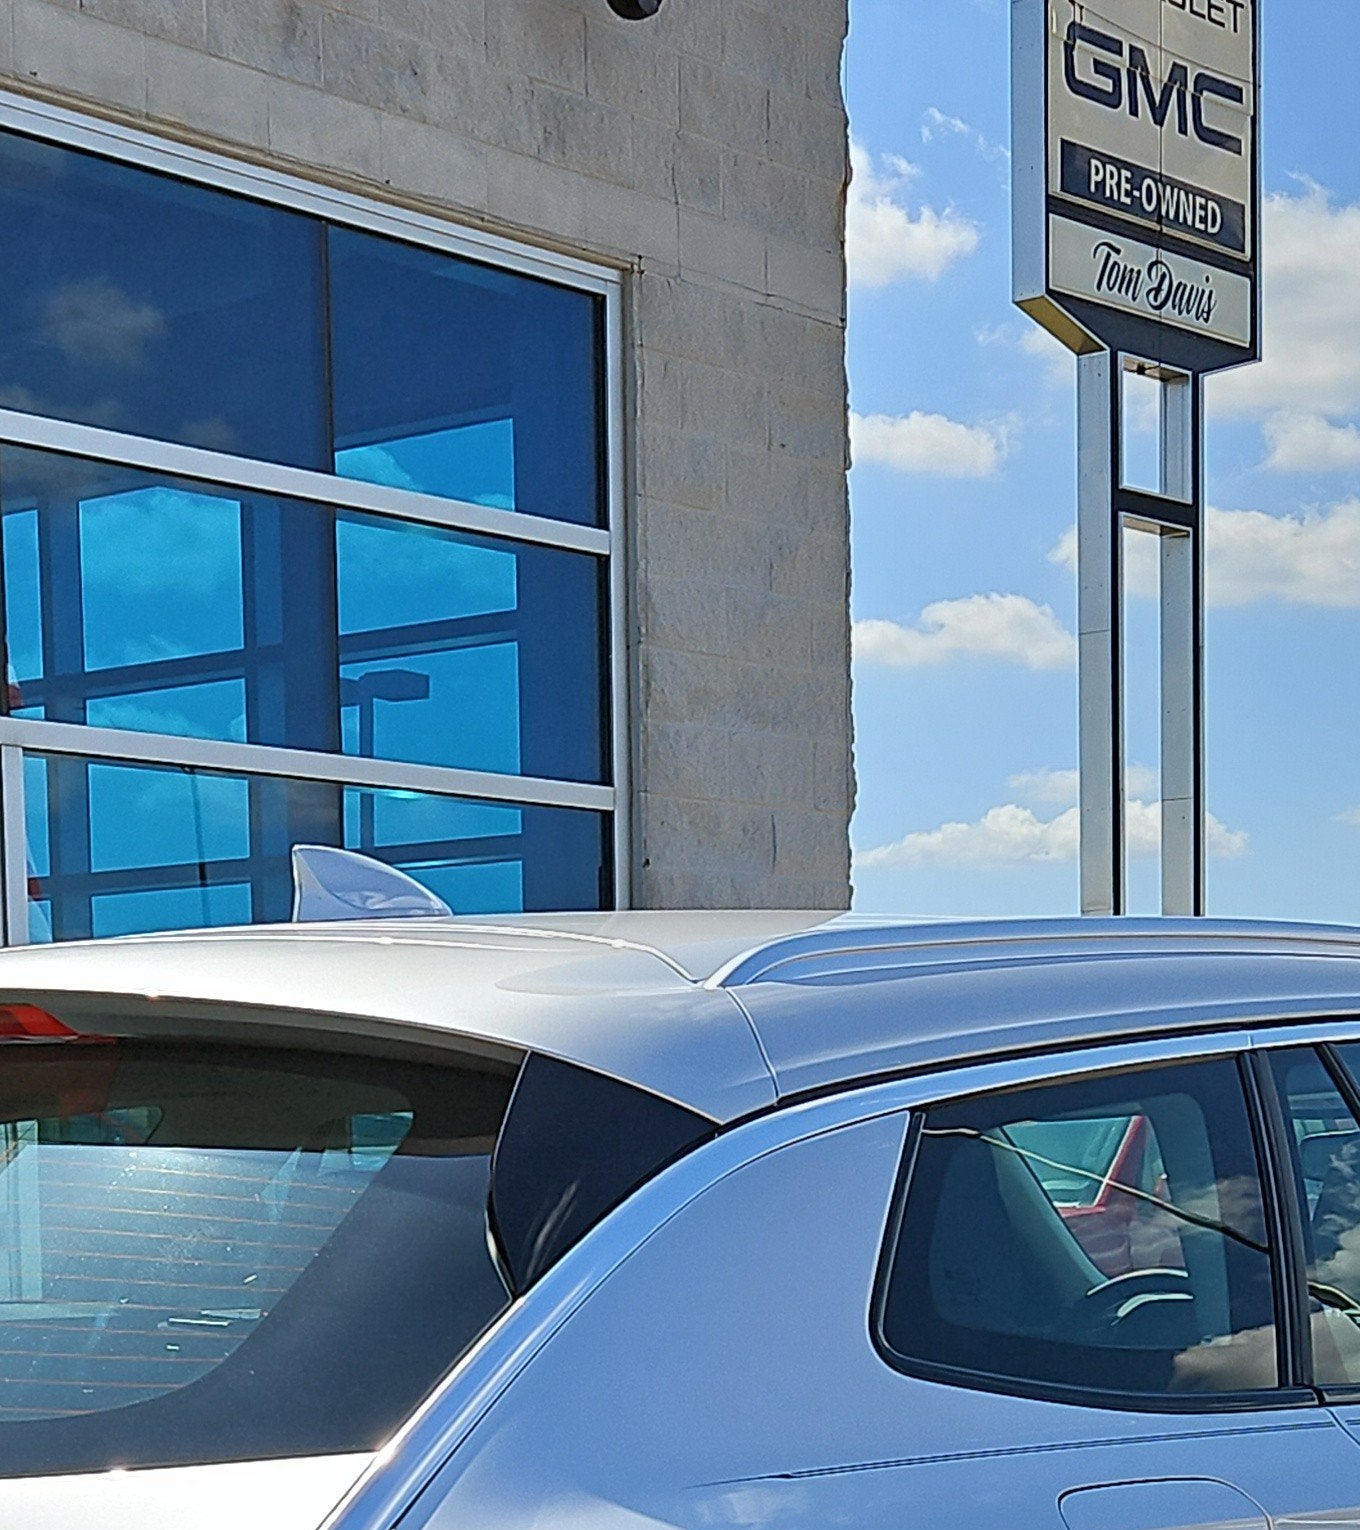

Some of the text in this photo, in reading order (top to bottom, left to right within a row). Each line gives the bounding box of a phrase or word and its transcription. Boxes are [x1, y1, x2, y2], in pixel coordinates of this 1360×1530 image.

[1063, 21, 1244, 156] GMC
[1090, 158, 1222, 234] PRE-OWNED
[1093, 241, 1217, 323] Tom Davis
